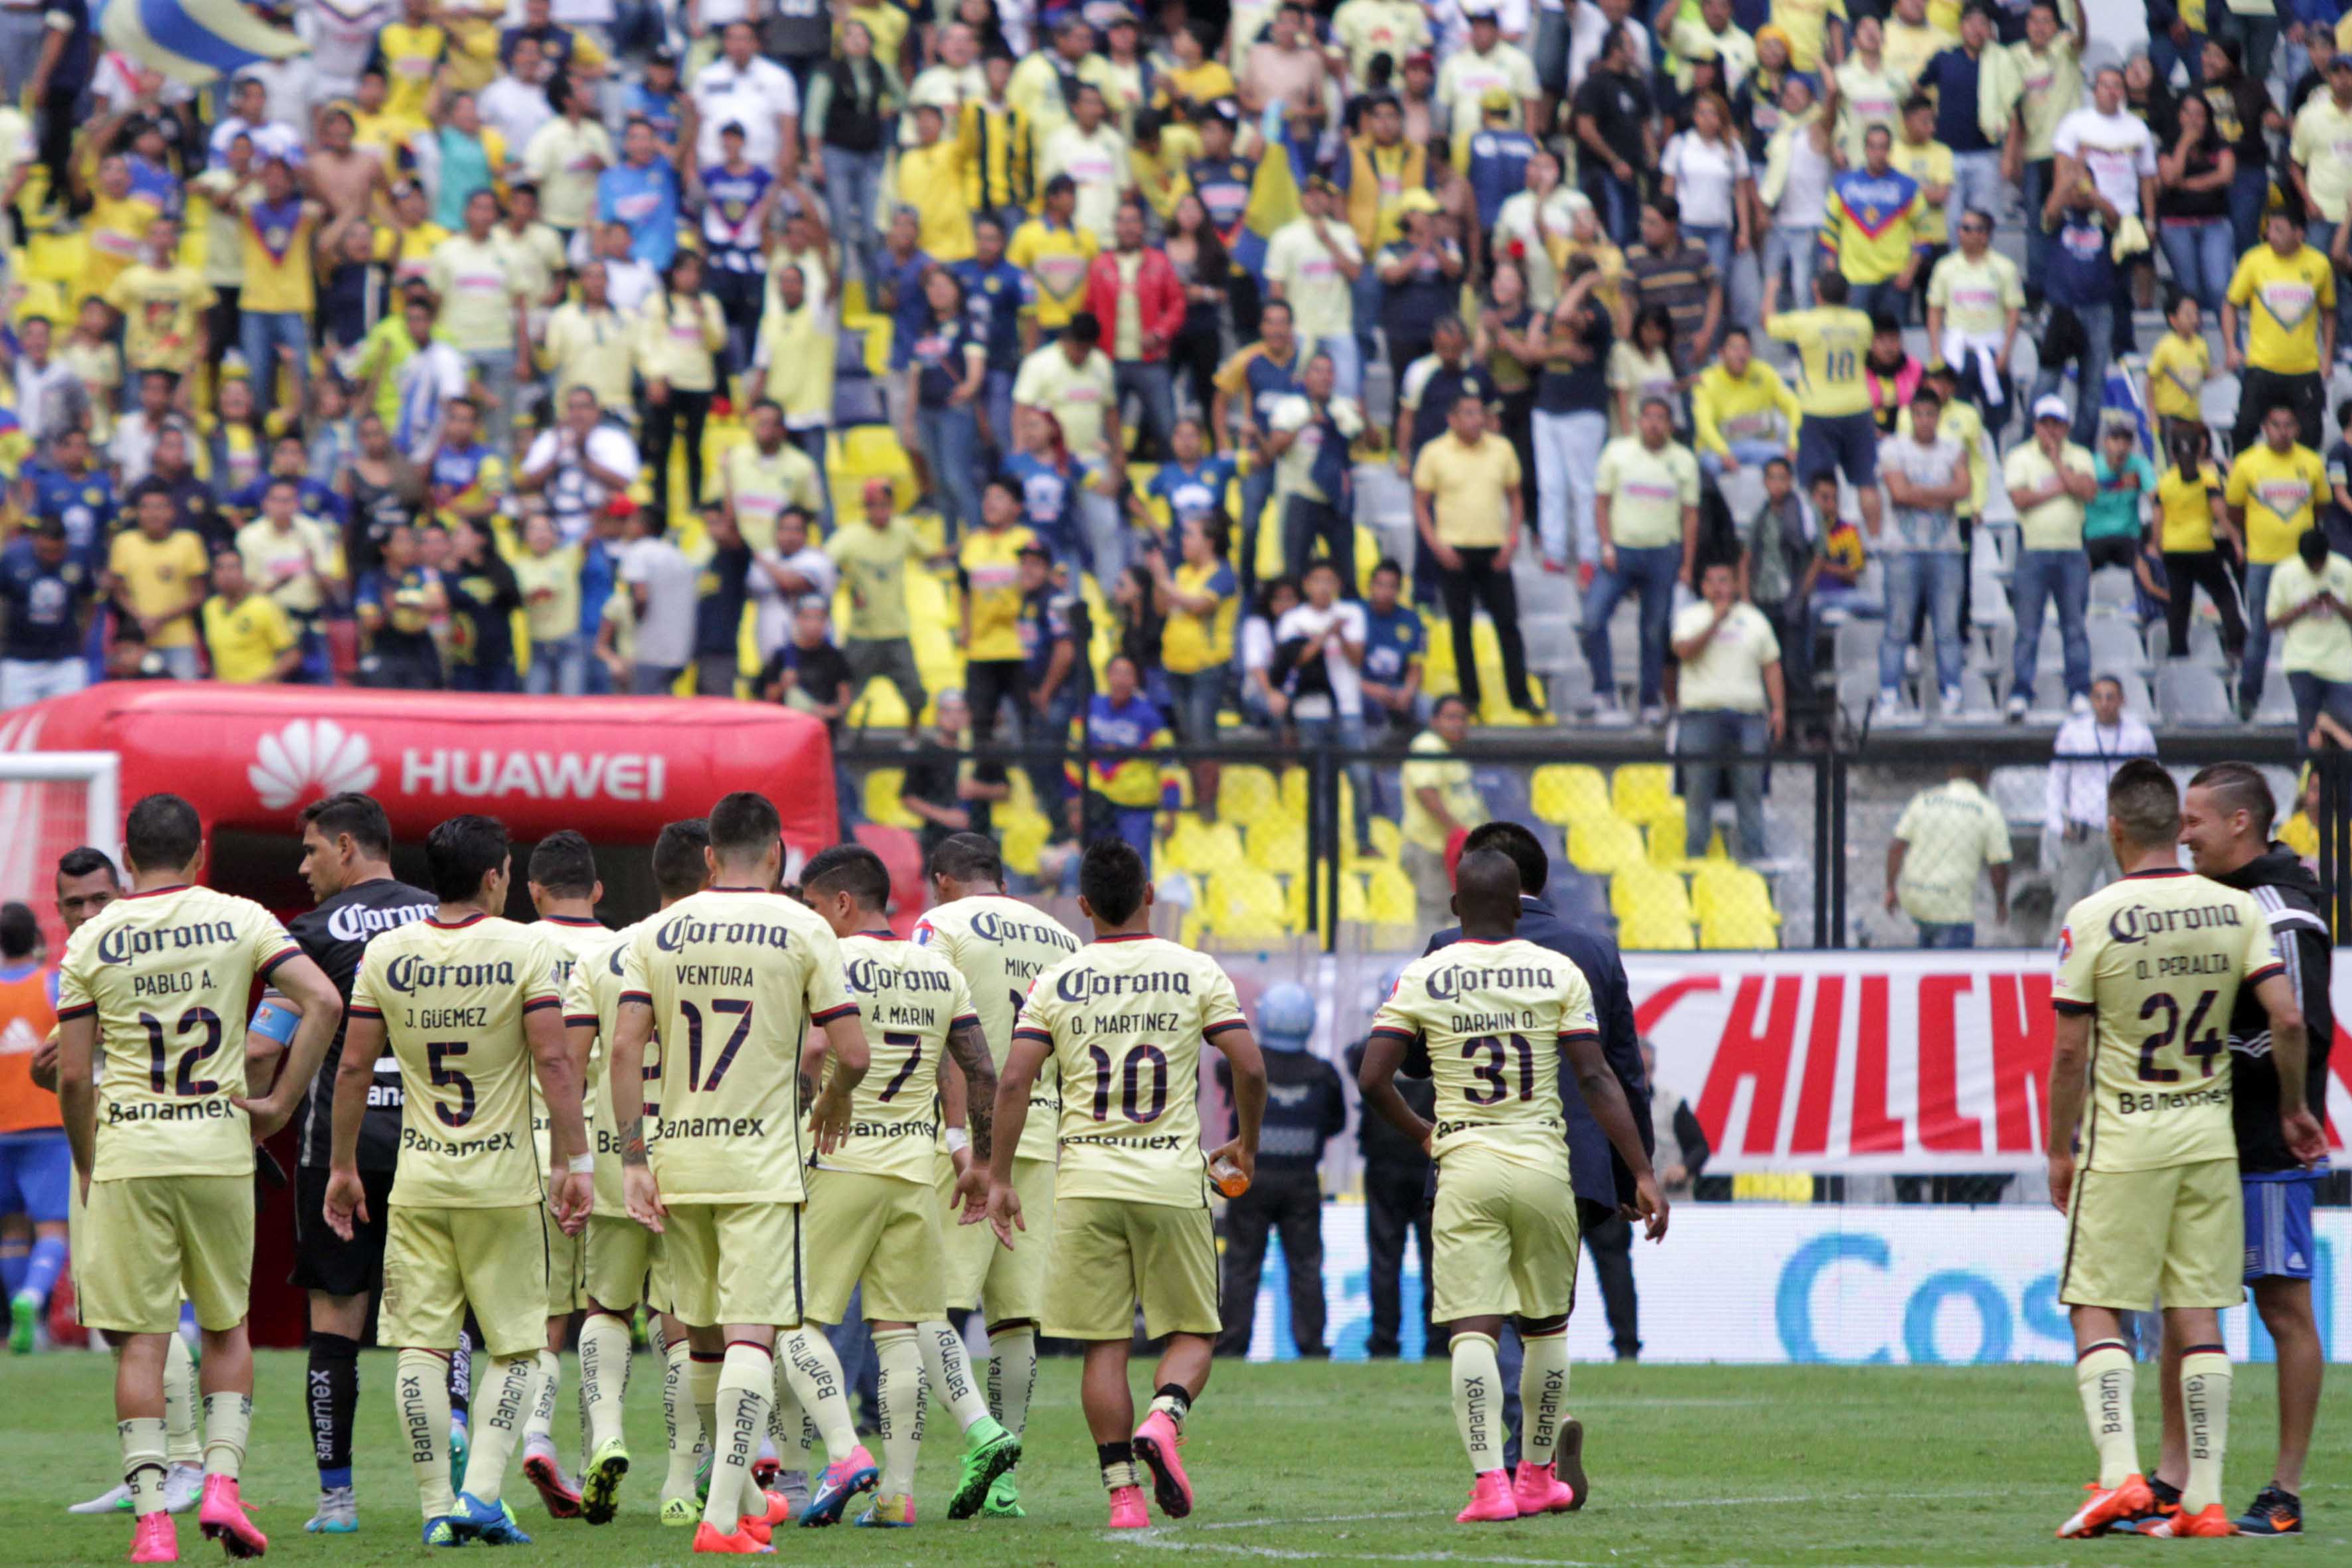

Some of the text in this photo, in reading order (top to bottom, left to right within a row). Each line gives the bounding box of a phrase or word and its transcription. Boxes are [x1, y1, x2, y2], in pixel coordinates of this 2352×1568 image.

[400, 747, 664, 801] HUAWEI
[99, 918, 237, 966] Corona
[328, 903, 439, 942] Coron
[657, 913, 789, 953] Corona
[971, 911, 1077, 953] Corona
[2108, 903, 2242, 945] Corona
[134, 967, 217, 996] PABLO A.
[386, 954, 515, 997] Corona
[676, 965, 753, 988] VENTURA
[848, 957, 952, 998] Corona
[1057, 967, 1191, 1006] Corona
[1426, 964, 1555, 1003] Corona
[2159, 954, 2231, 976] PERALTA
[406, 1008, 487, 1028] J. GÜEMEZ
[872, 1004, 935, 1026] A. MARIN
[1095, 1012, 1179, 1034] MARTINEZ
[1452, 1011, 1538, 1034] DARWIN O.
[2138, 990, 2223, 1082] 24
[139, 1006, 222, 1096] 12
[680, 999, 753, 1092] 17
[878, 1030, 921, 1103] 7
[1461, 1033, 1534, 1105] 31
[426, 1042, 475, 1127] 5
[1089, 1044, 1168, 1124] 10
[109, 1098, 234, 1124] Banamex
[839, 1120, 935, 1138] aname
[403, 1127, 515, 1156] Banamex
[582, 1338, 602, 1407] Banamex
[787, 1333, 837, 1401] Banamex
[935, 1329, 969, 1403] Banamex
[987, 1356, 1003, 1425] anamex
[310, 1370, 333, 1460] Banamex
[402, 1375, 433, 1464] Banamex
[489, 1358, 528, 1431] Banamex
[1464, 1376, 1488, 1452] Banamex
[1533, 1370, 1565, 1447] Banamex
[2101, 1372, 2122, 1434] Banam
[726, 1388, 761, 1468] Baname
